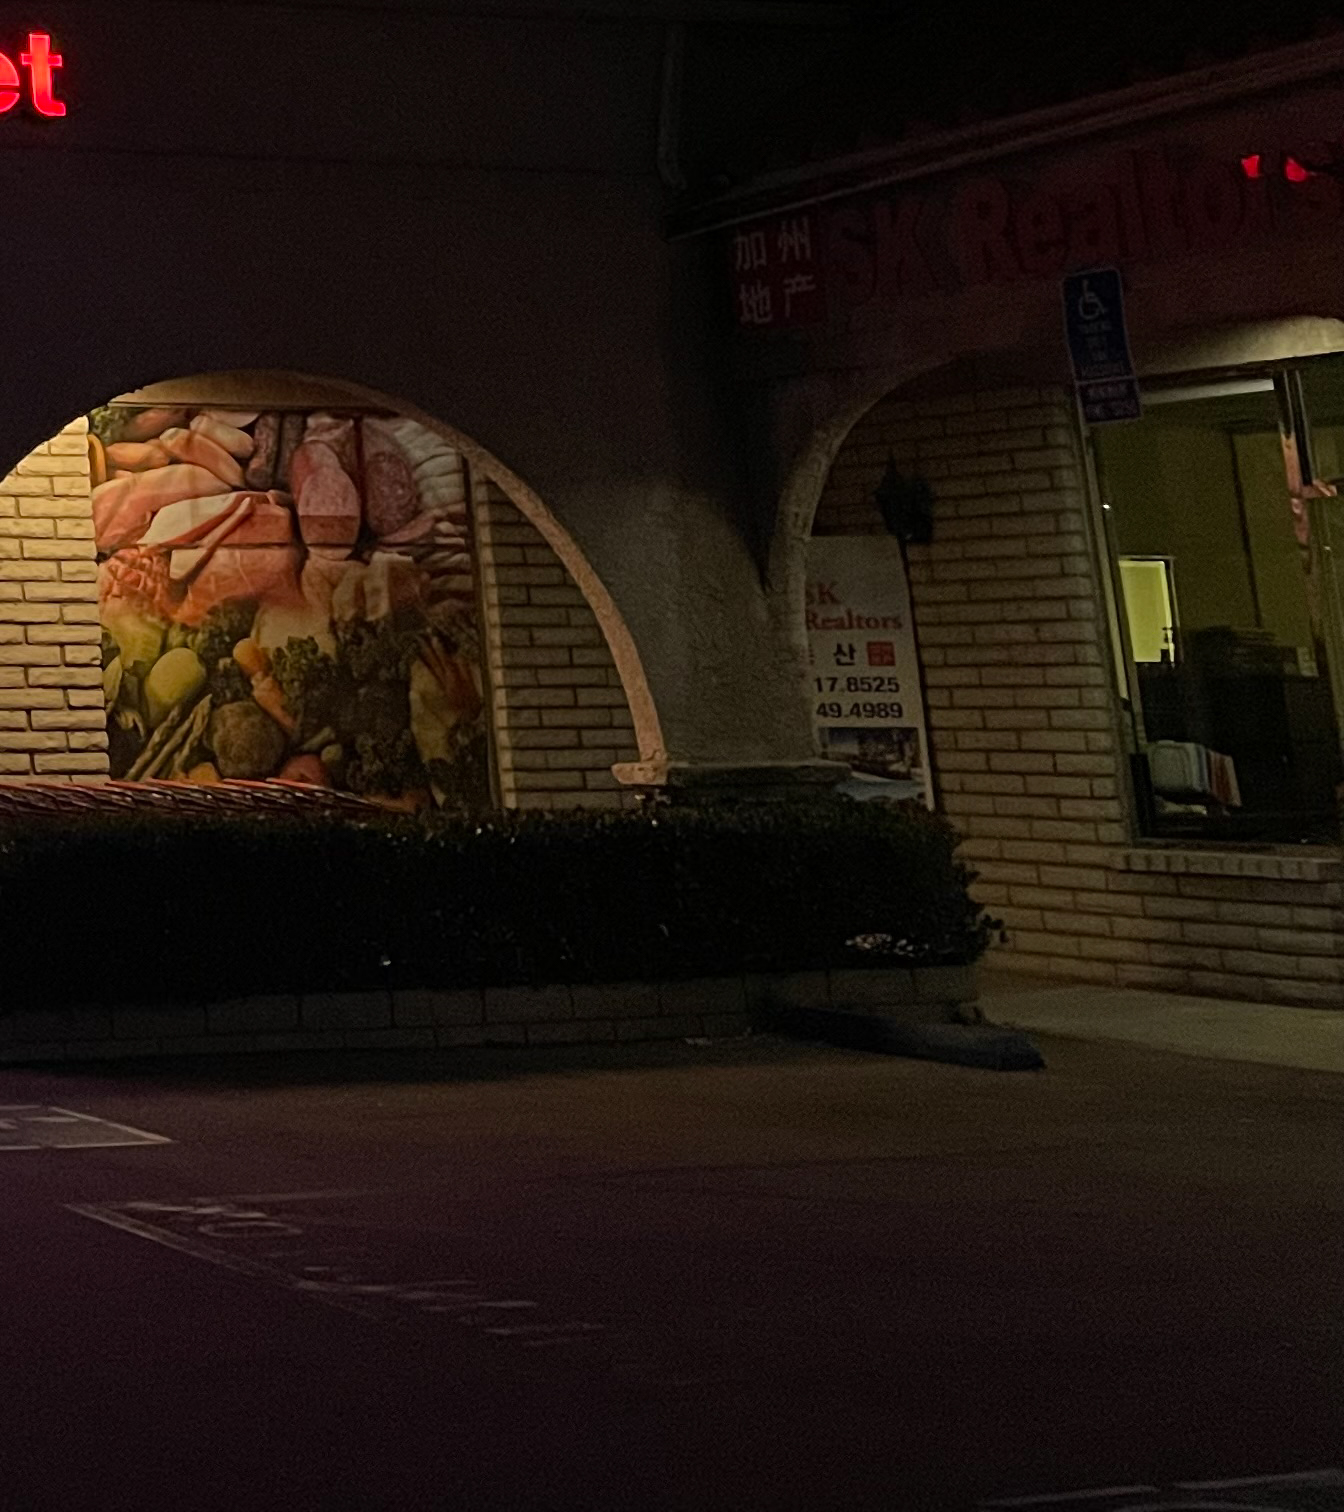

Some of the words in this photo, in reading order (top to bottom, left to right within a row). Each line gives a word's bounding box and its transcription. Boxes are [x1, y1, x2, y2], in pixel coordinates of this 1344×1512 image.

[732, 215, 812, 272] 加州
[738, 273, 817, 326] 地产
[806, 607, 903, 630] Realtors
